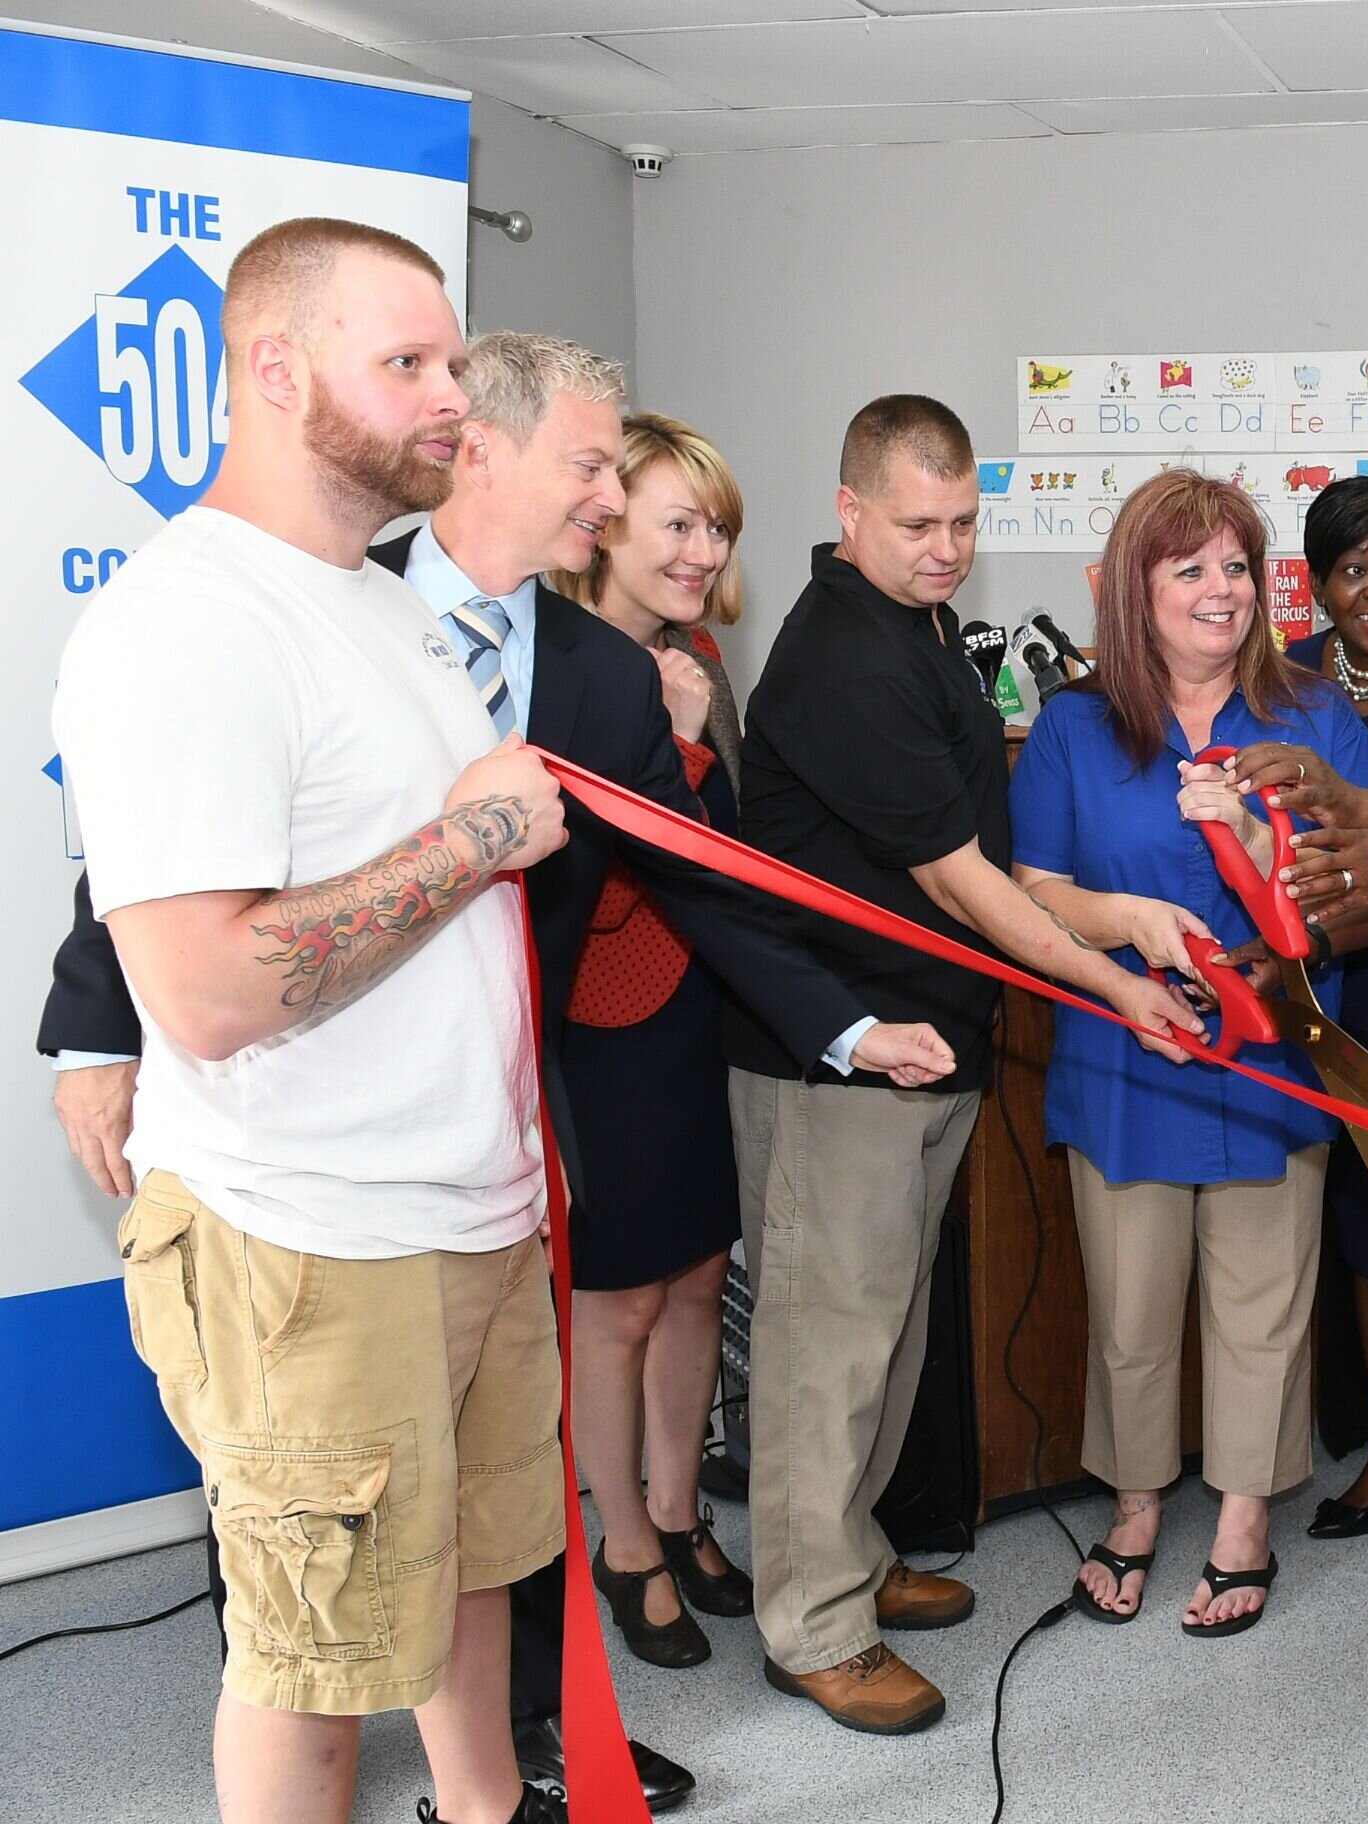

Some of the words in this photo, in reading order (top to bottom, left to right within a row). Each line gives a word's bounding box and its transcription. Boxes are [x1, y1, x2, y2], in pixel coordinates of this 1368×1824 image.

[126, 185, 222, 242] THE
[1028, 404, 1075, 434] Aa
[1099, 404, 1141, 434] Bb
[1158, 403, 1198, 433] Cc
[1220, 403, 1262, 433] Dd
[1291, 403, 1324, 434] Ee
[1034, 506, 1073, 535] Nn
[62, 547, 129, 594] CO
[1269, 561, 1279, 576] IF
[1282, 560, 1287, 575] I
[1275, 575, 1299, 591] RAN
[1270, 591, 1292, 607] THE
[1270, 605, 1310, 623] CIRCUS
[962, 628, 1003, 646] BFO
[981, 637, 1005, 649] FM
[998, 697, 1020, 709] Seuss
